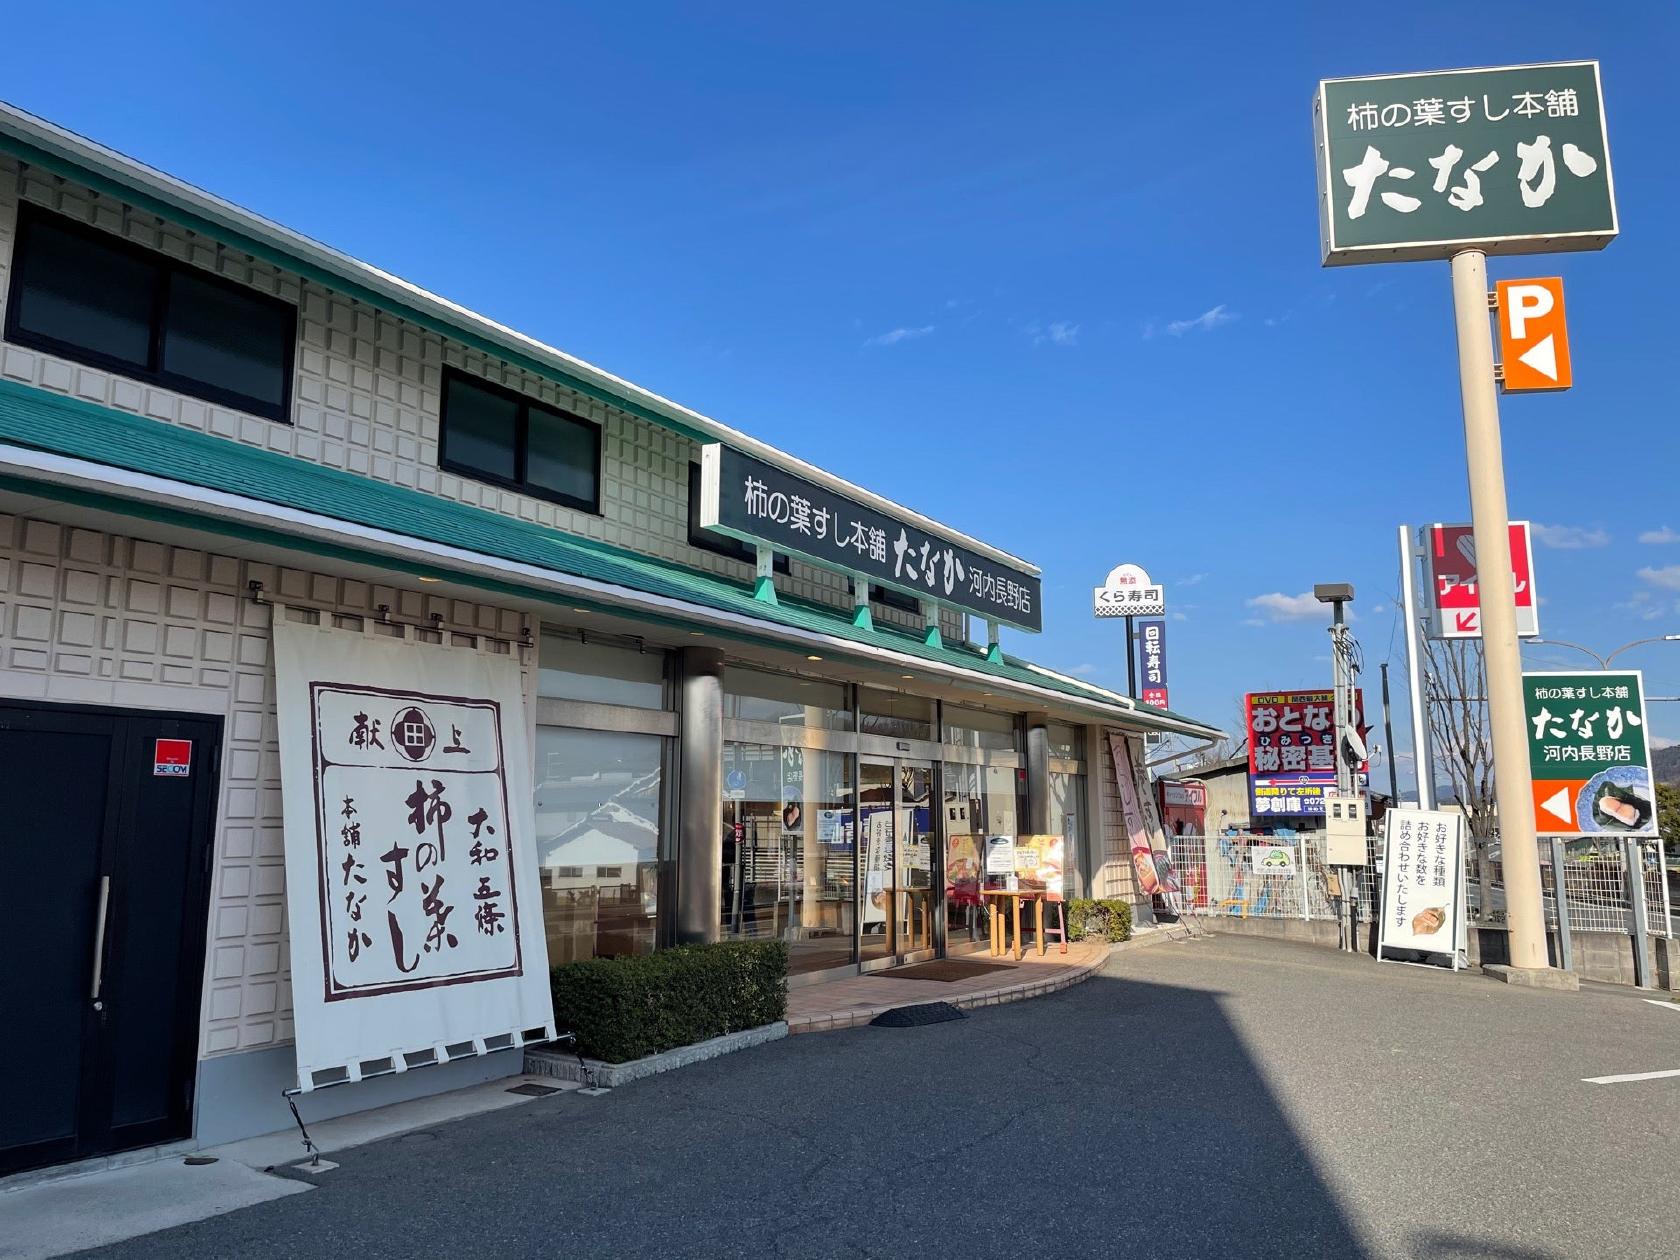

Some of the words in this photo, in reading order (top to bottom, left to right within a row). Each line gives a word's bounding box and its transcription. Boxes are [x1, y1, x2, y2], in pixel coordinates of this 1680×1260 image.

[1347, 88, 1579, 131] 柿の葉すし本舗
[1342, 135, 1598, 220] たなか
[1507, 285, 1554, 339] P
[745, 475, 886, 563] 柿の葉すし本舗
[893, 527, 965, 595] たなか
[969, 566, 1031, 614] 河内長野店
[1099, 589, 1159, 603] くら寿司
[1145, 626, 1161, 683] 回転寿司
[1535, 686, 1629, 699] 柿の葉すし本舗
[1532, 706, 1642, 740] たなか
[156, 765, 187, 774] SECOM
[1544, 745, 1631, 762] 河内長野店
[1396, 819, 1412, 928] 詰め合わせいたします
[1415, 821, 1429, 886] お好きな数を
[1432, 821, 1447, 888] お好きな種類
